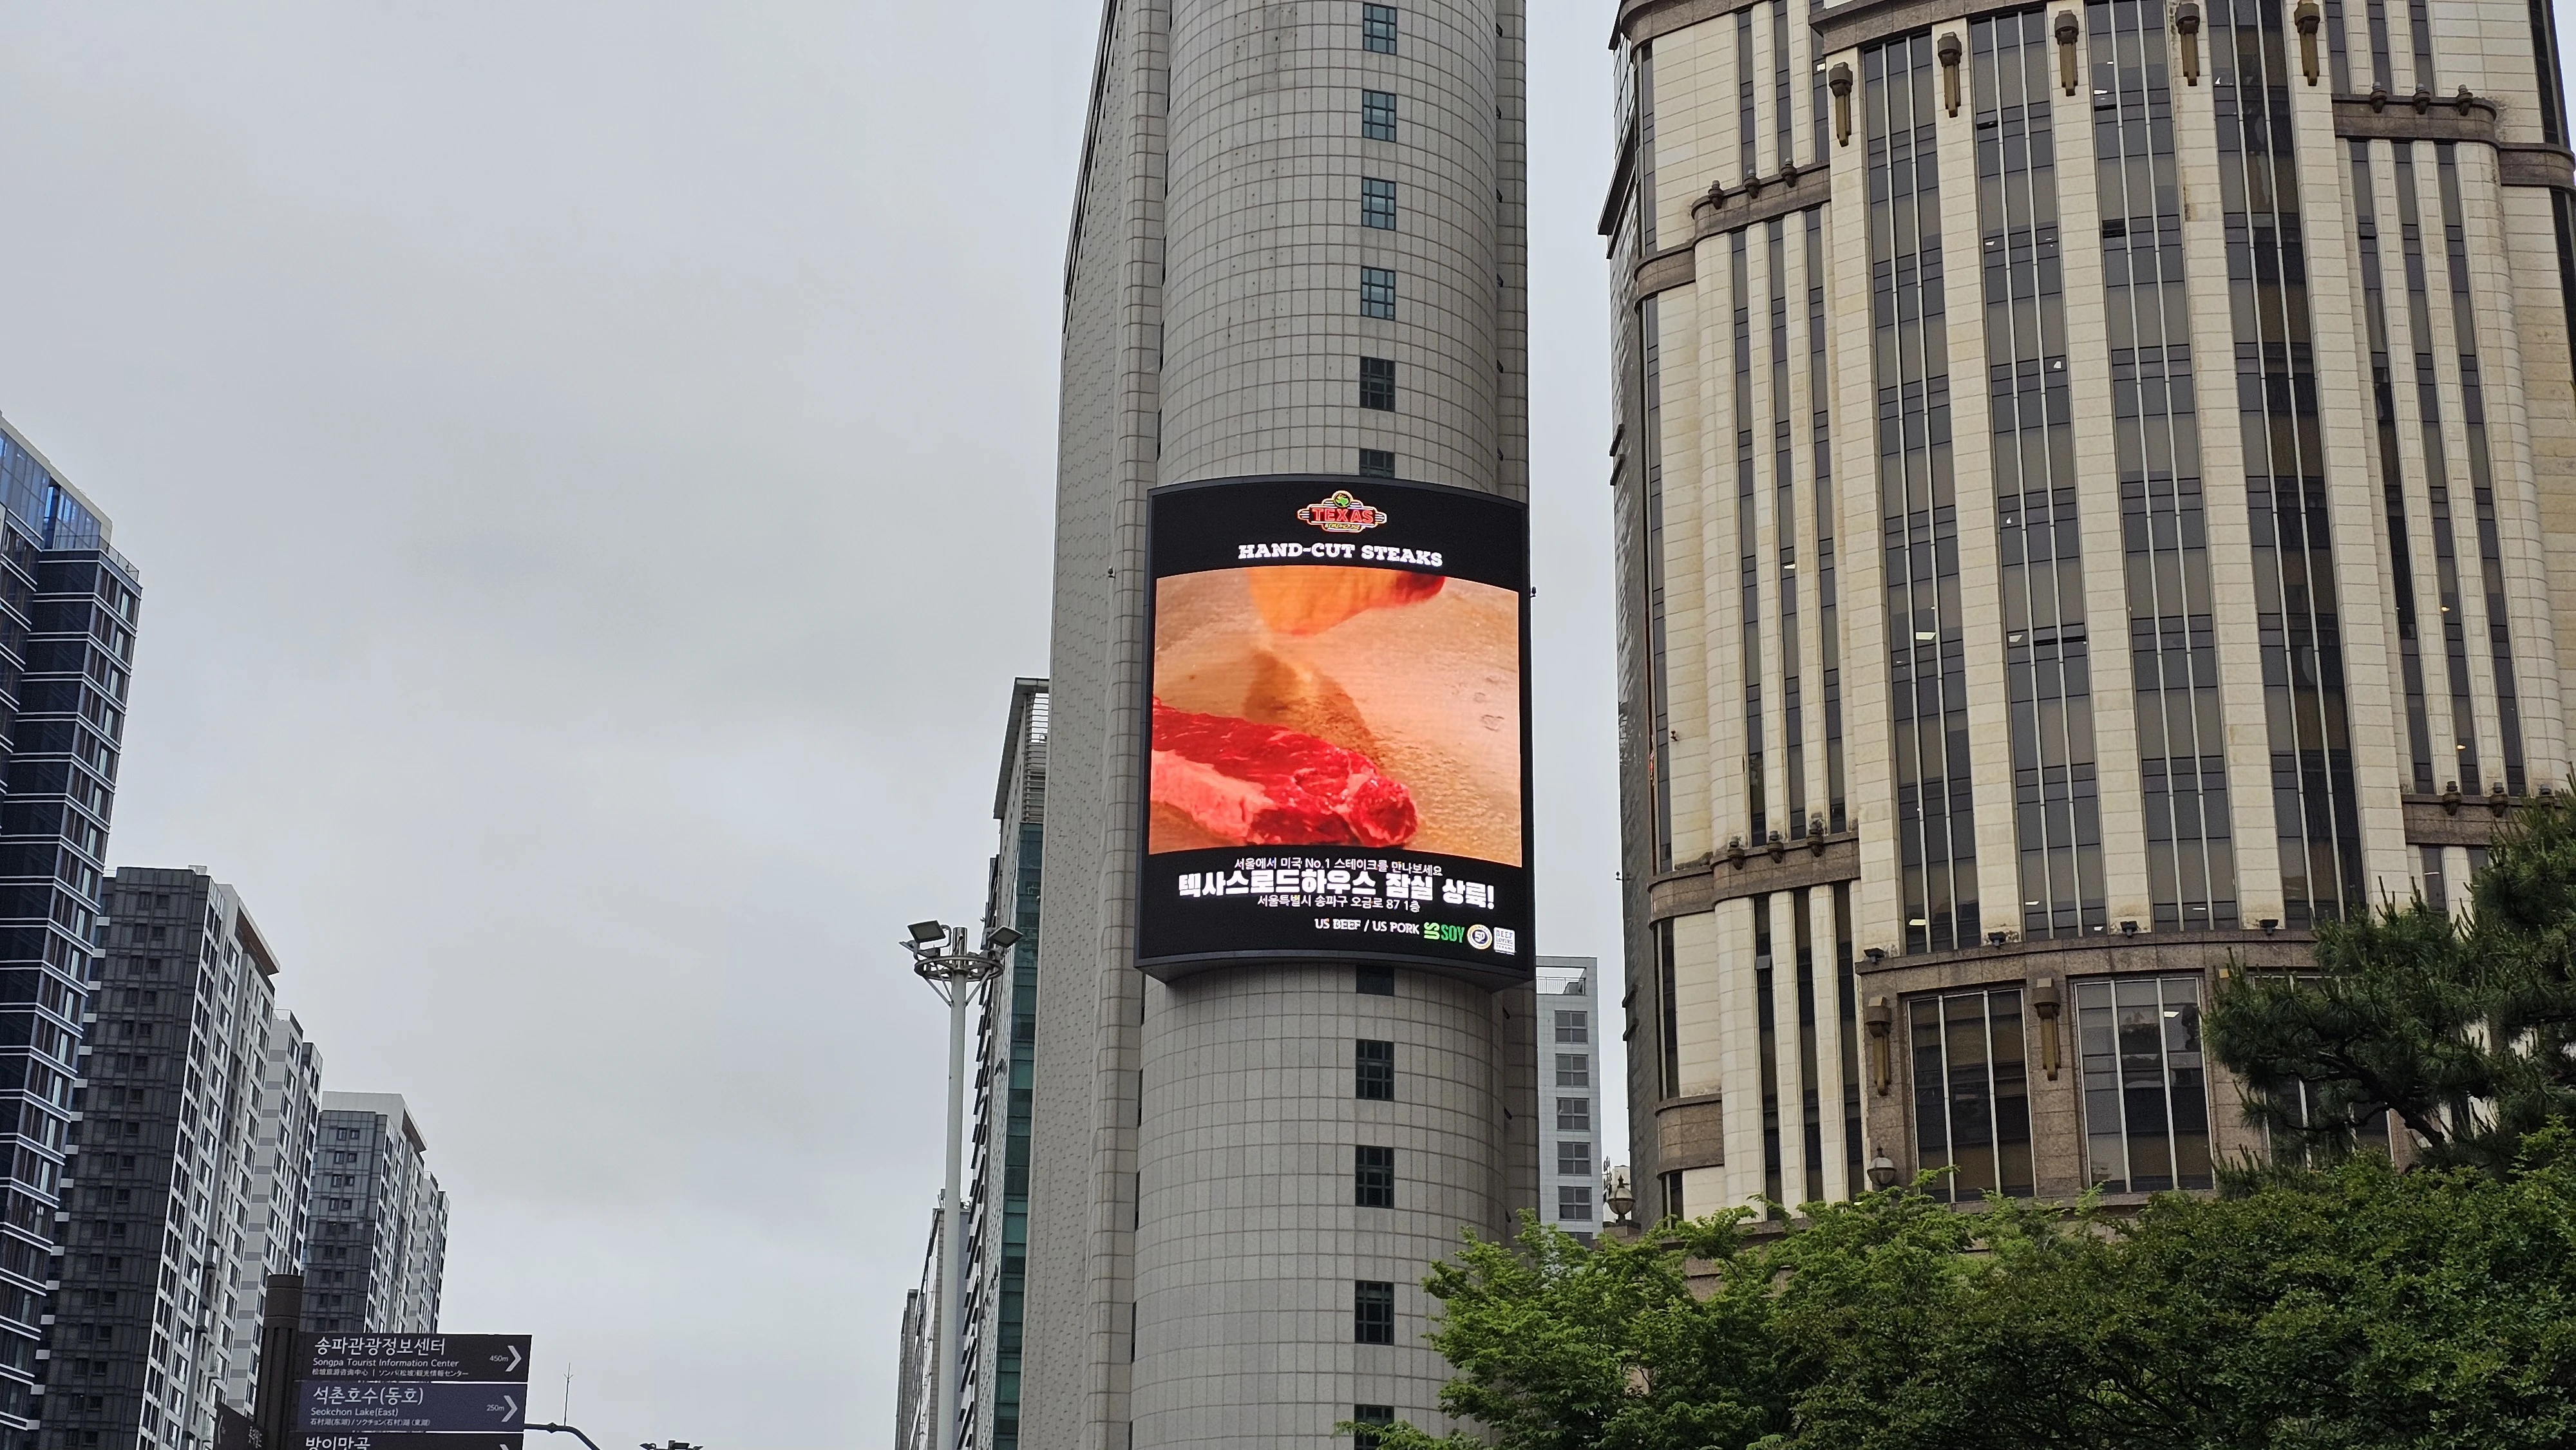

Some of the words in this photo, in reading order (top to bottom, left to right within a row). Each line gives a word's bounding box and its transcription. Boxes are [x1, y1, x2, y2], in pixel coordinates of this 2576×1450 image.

[1312, 508, 1374, 523] TEXAS
[1238, 543, 1355, 559] HAND-CUT
[1361, 545, 1443, 567] STEAKS
[1235, 857, 1276, 870] 서울에서
[1281, 857, 1302, 869] 미국
[1305, 858, 1331, 869] No.1
[1334, 858, 1388, 872] 스테이크를
[1391, 861, 1443, 877] 만나보세요
[1179, 869, 1376, 898] 텍사스로드하우스
[1385, 872, 1434, 901] 잠실
[1441, 878, 1495, 910] 상륙!
[1257, 894, 1312, 907] 서울특별시
[1314, 894, 1349, 909] 송파구
[1350, 896, 1384, 909] 오금로
[1386, 899, 1401, 910] 87
[1404, 899, 1421, 912] 1층
[1314, 918, 1330, 929] US
[1333, 919, 1361, 930] BEEF
[1372, 921, 1387, 932] US
[1389, 922, 1420, 935] PORK
[1424, 922, 1440, 940] US
[1441, 924, 1465, 943] SOY
[1495, 930, 1513, 939] BEEF
[314, 1336, 446, 1356] 송파관광정보센터
[312, 1358, 344, 1367] Songpa
[347, 1358, 376, 1366] Tourist
[379, 1358, 428, 1367] Information
[431, 1359, 459, 1367] Center
[314, 1386, 424, 1406] 석촌호수(동호)
[310, 1407, 352, 1416] Seokchon
[355, 1407, 399, 1417] Lake(East)
